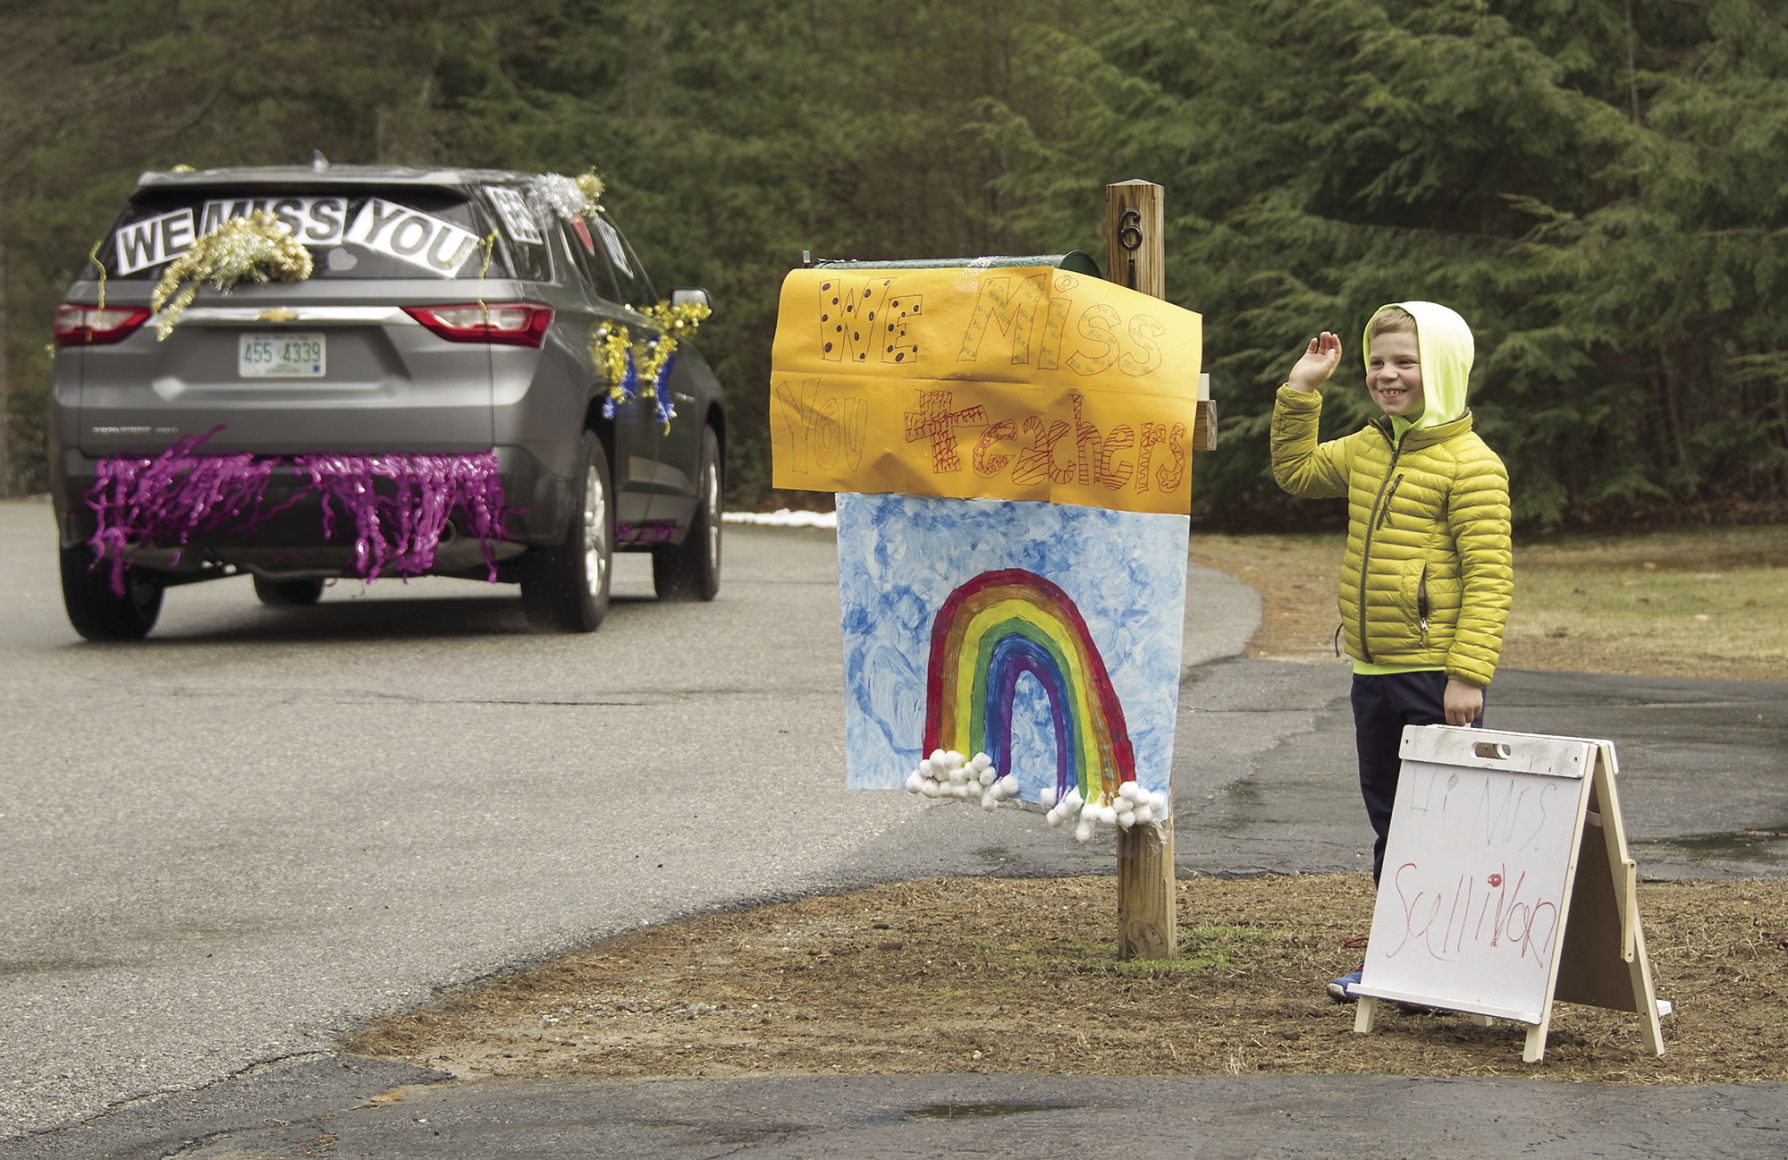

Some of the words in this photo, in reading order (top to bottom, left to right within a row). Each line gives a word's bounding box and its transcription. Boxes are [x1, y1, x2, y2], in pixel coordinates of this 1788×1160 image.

[121, 212, 190, 269] WE
[364, 199, 472, 271] YOU
[1118, 208, 1143, 252] 6
[819, 276, 924, 364] WE
[244, 341, 273, 363] 455
[282, 341, 321, 363] 4339
[1410, 768, 1459, 828] Hi
